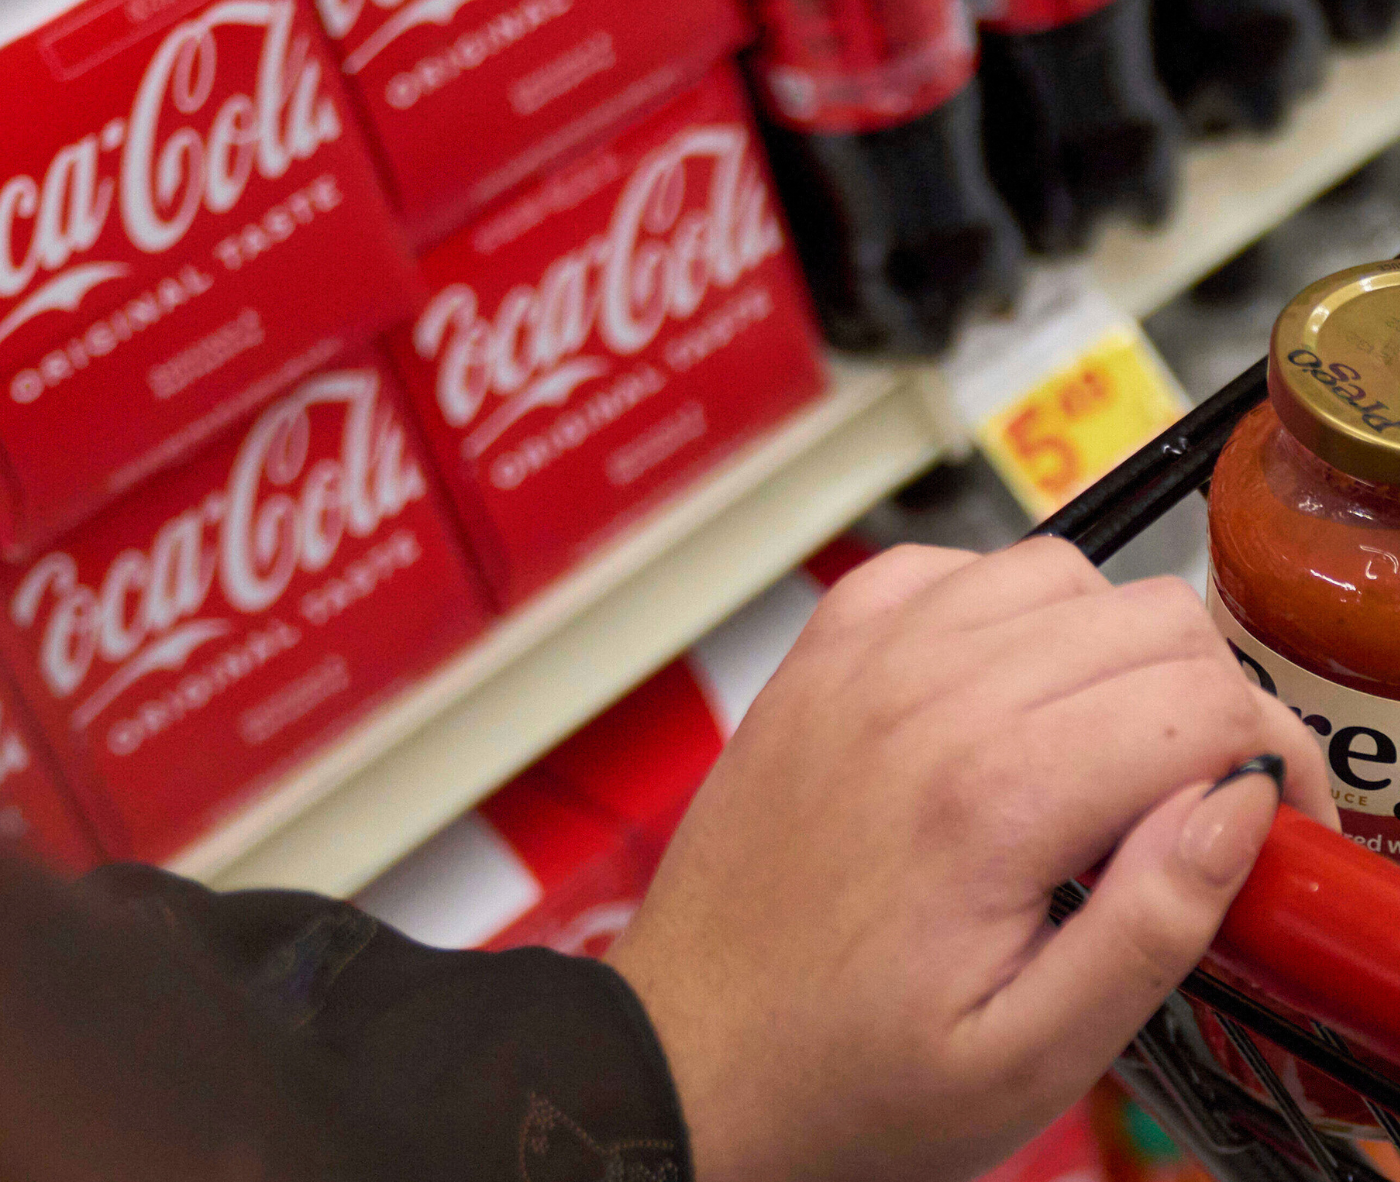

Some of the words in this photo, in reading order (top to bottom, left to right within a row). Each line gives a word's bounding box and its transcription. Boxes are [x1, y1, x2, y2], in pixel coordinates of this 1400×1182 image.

[0, 0, 342, 335] ca-Cola
[10, 264, 214, 404] ORIGINAL
[213, 174, 343, 271] TASTE
[1331, 788, 1367, 806] UCE
